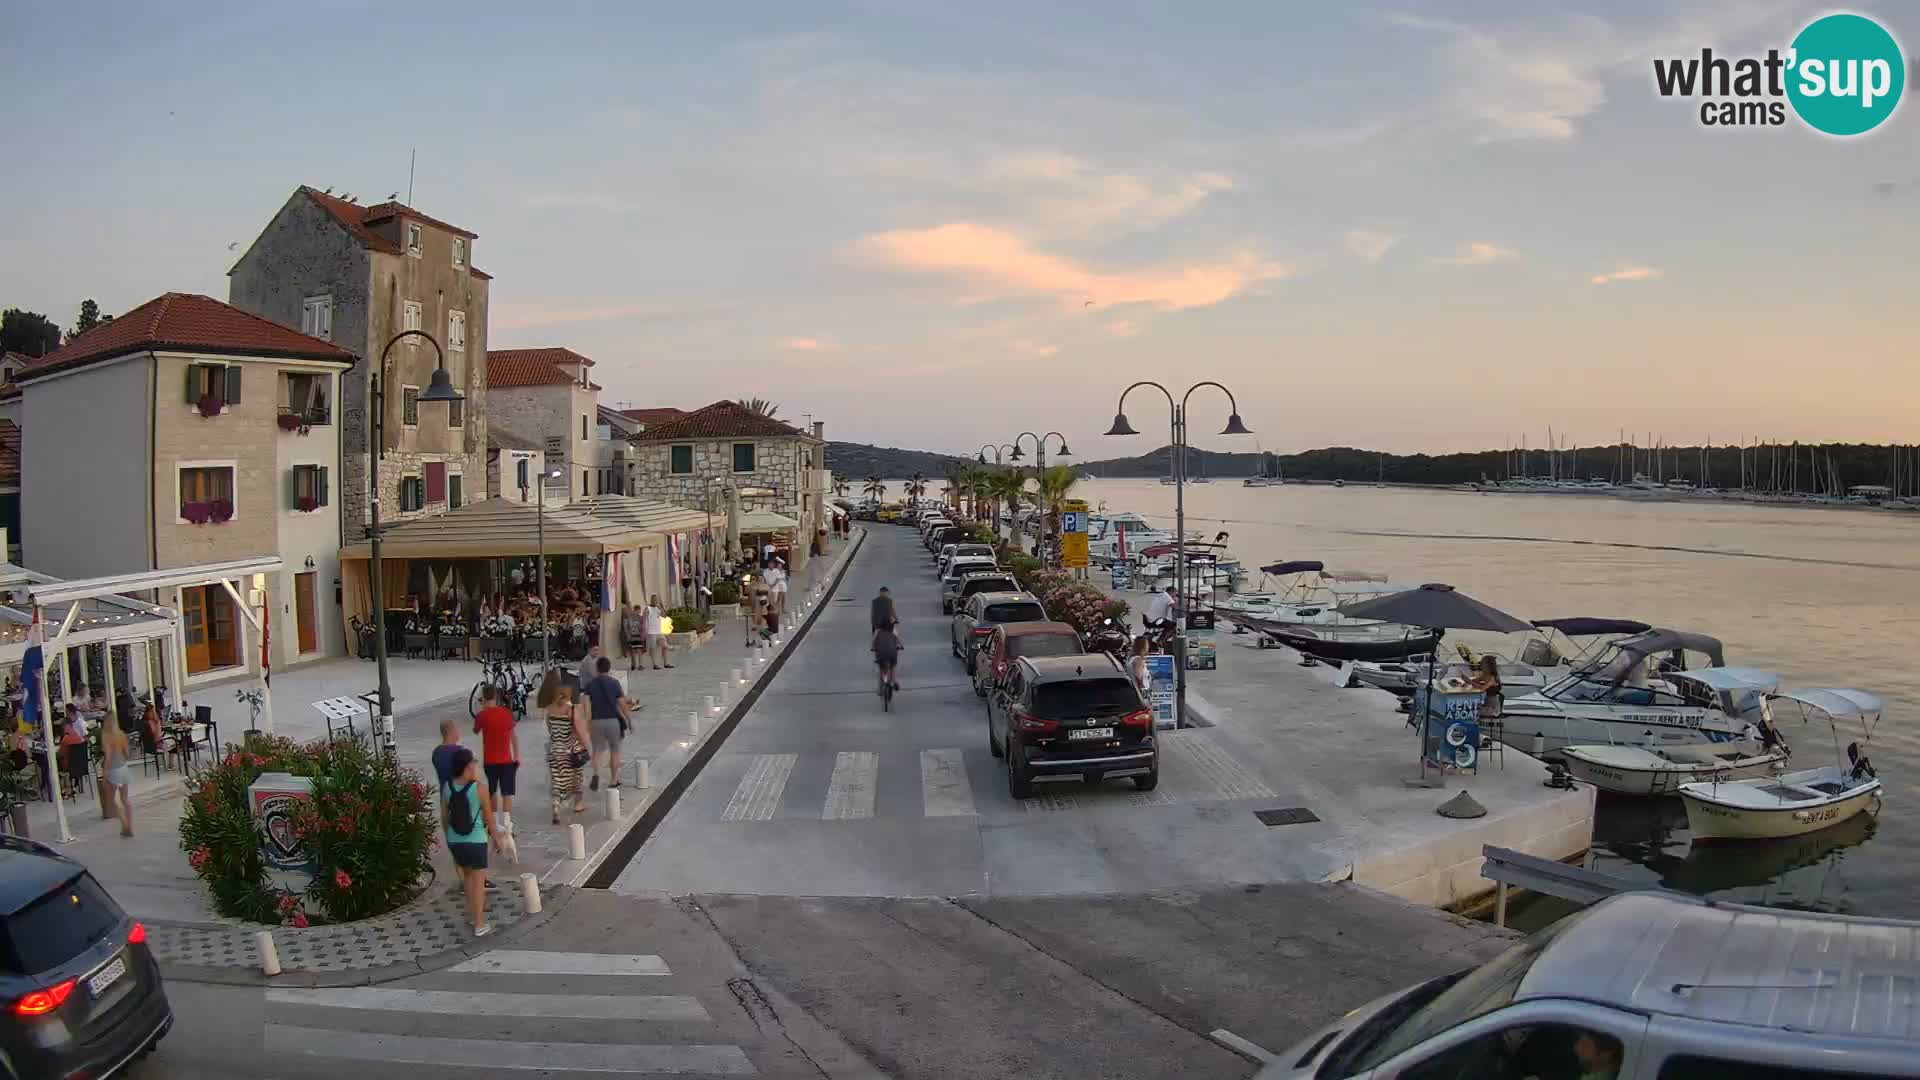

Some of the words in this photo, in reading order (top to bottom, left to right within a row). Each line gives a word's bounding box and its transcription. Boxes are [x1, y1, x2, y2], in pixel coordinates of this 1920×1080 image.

[1065, 514, 1075, 530] P
[1447, 699, 1479, 710] RENT
[1446, 711, 1453, 720] A
